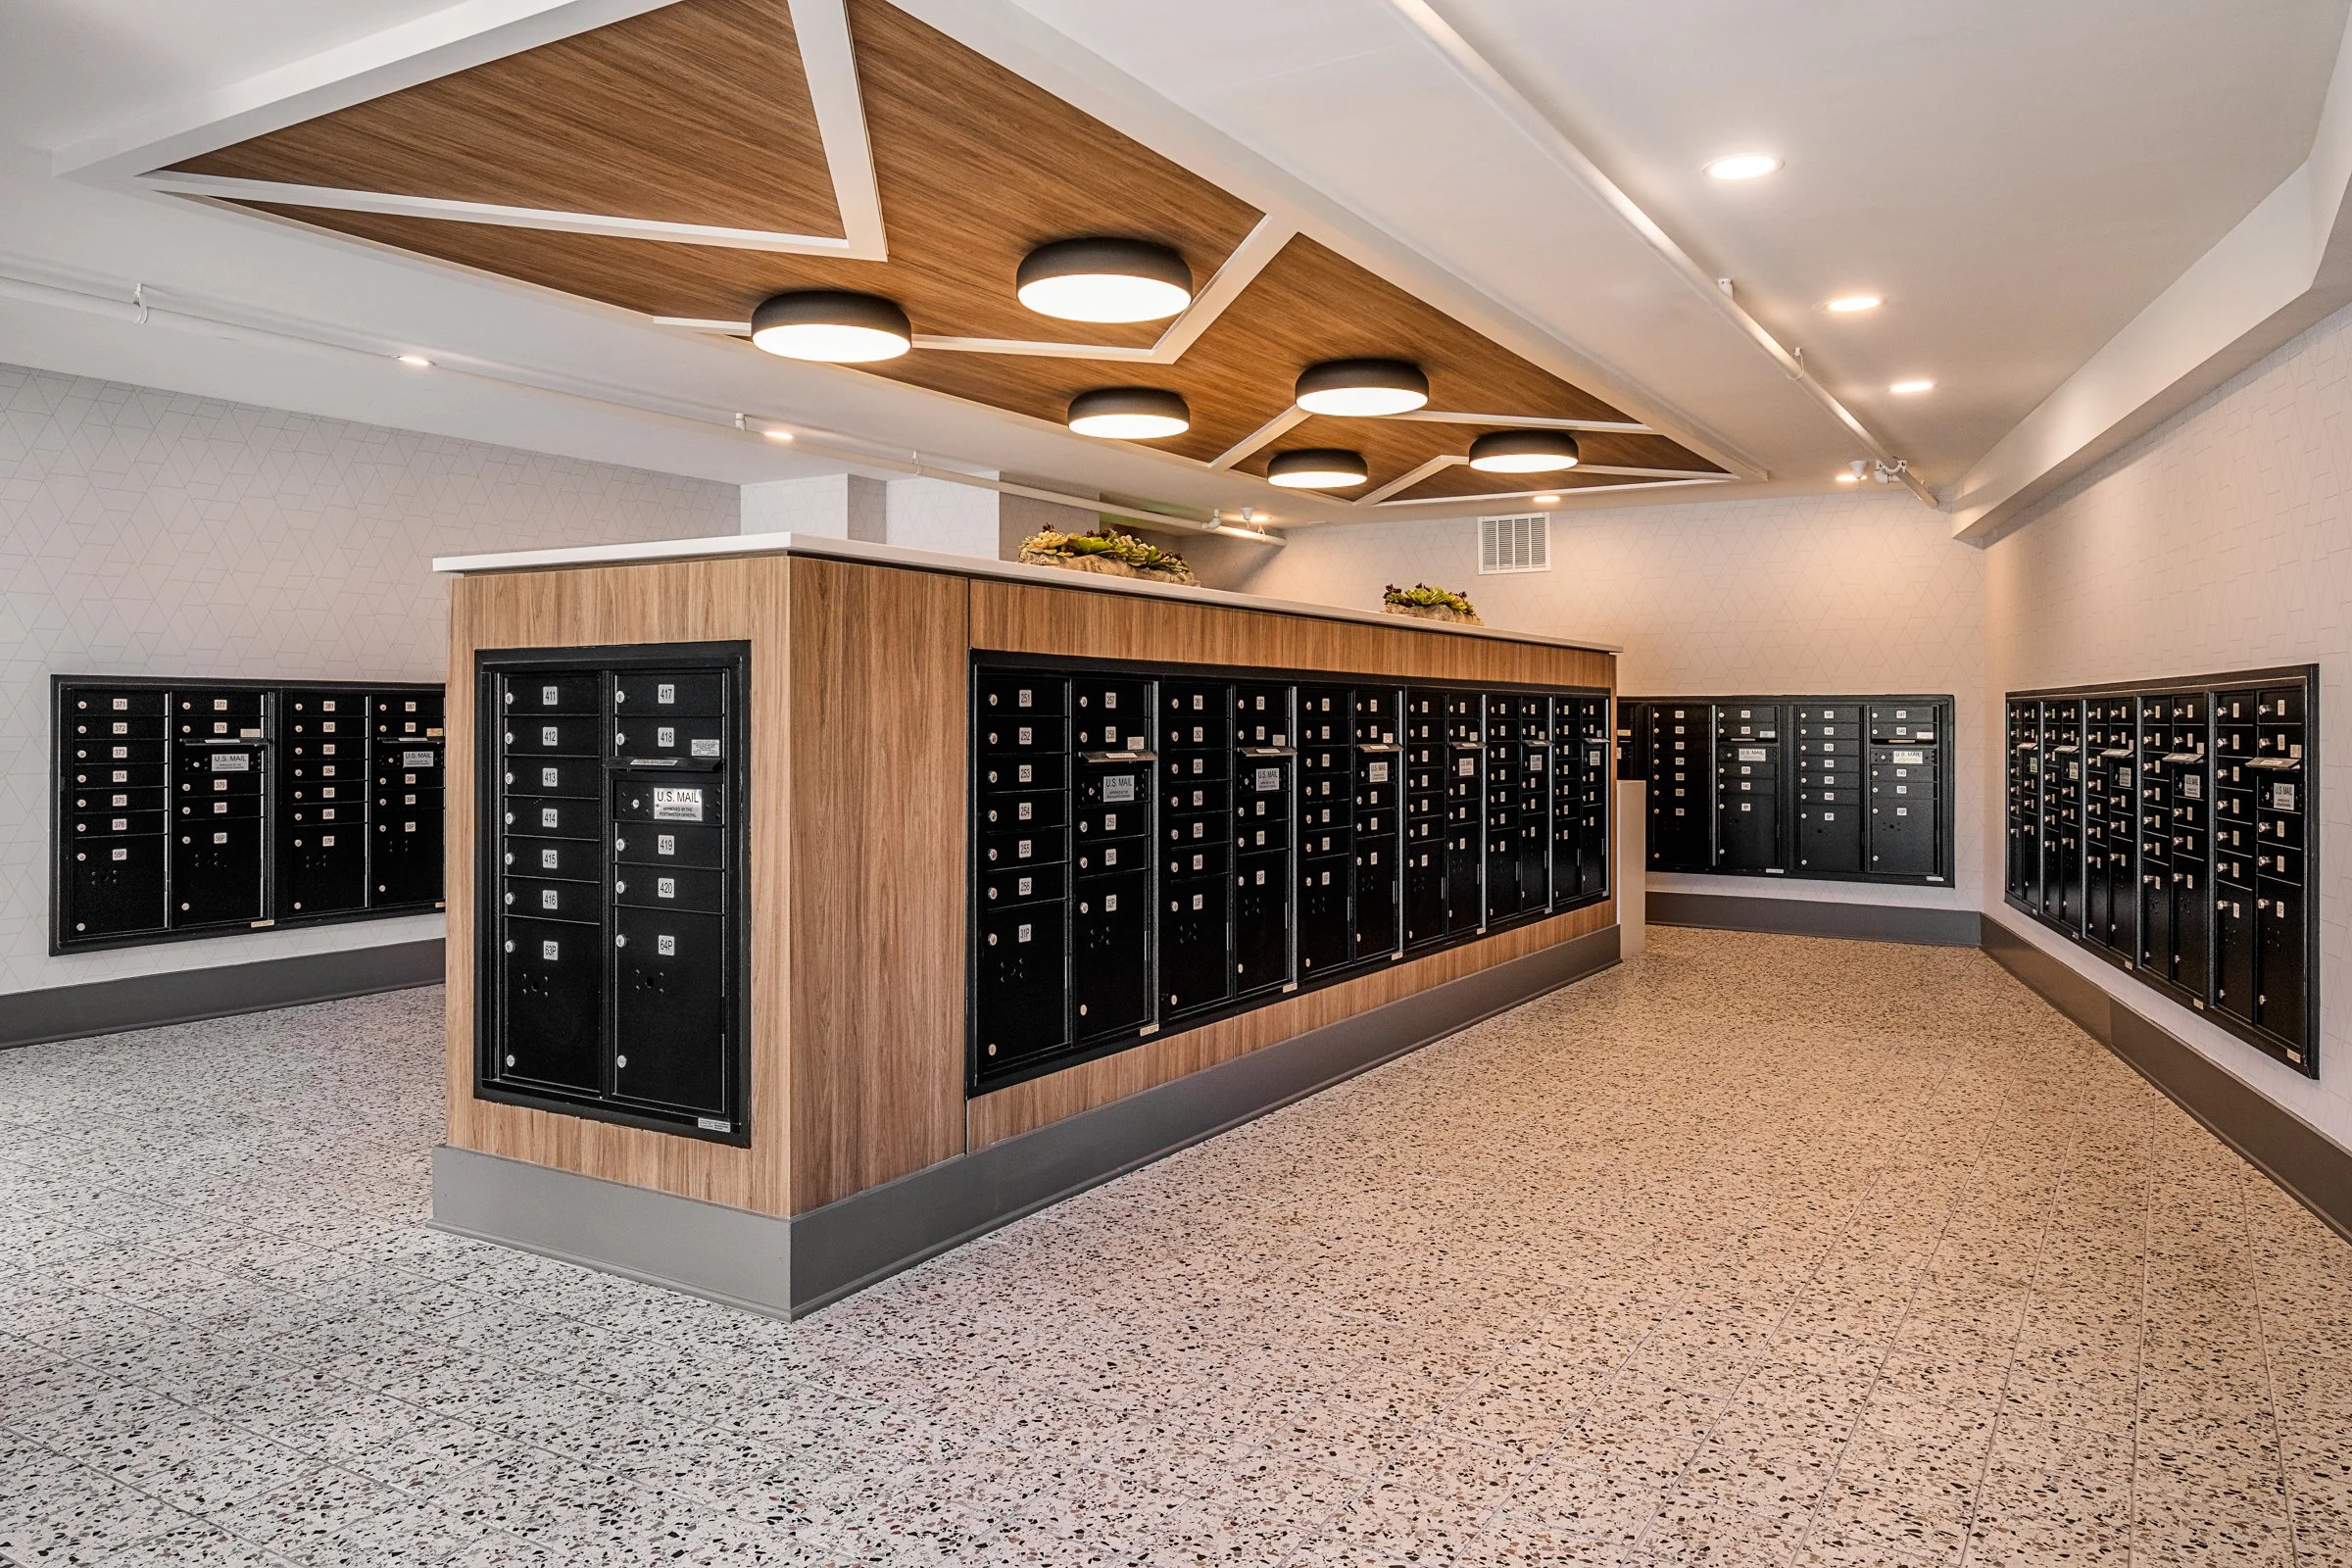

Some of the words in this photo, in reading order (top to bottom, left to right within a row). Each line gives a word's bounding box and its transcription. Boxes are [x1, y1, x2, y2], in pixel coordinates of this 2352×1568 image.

[545, 691, 556, 701] 411
[661, 688, 672, 700] 417
[1021, 693, 1030, 704] 251
[545, 731, 556, 742] 412
[661, 732, 672, 743] 418
[1021, 731, 1030, 741] 252
[545, 772, 556, 783] 413
[1020, 768, 1030, 779] 253
[1105, 777, 1118, 788] U.S.
[1118, 777, 1133, 787] MAIL
[657, 791, 675, 803] U.S.
[676, 791, 700, 804] MAIL
[1020, 806, 1030, 816] 254
[544, 812, 556, 823] 414
[660, 839, 672, 851] 419
[1020, 844, 1030, 855] 255
[544, 854, 556, 864] 415
[660, 882, 672, 894] 420
[1020, 881, 1030, 892] 256
[545, 894, 556, 906] 416
[1020, 928, 1029, 939] 31P
[545, 945, 557, 956] 63P
[661, 939, 672, 951] 64P
